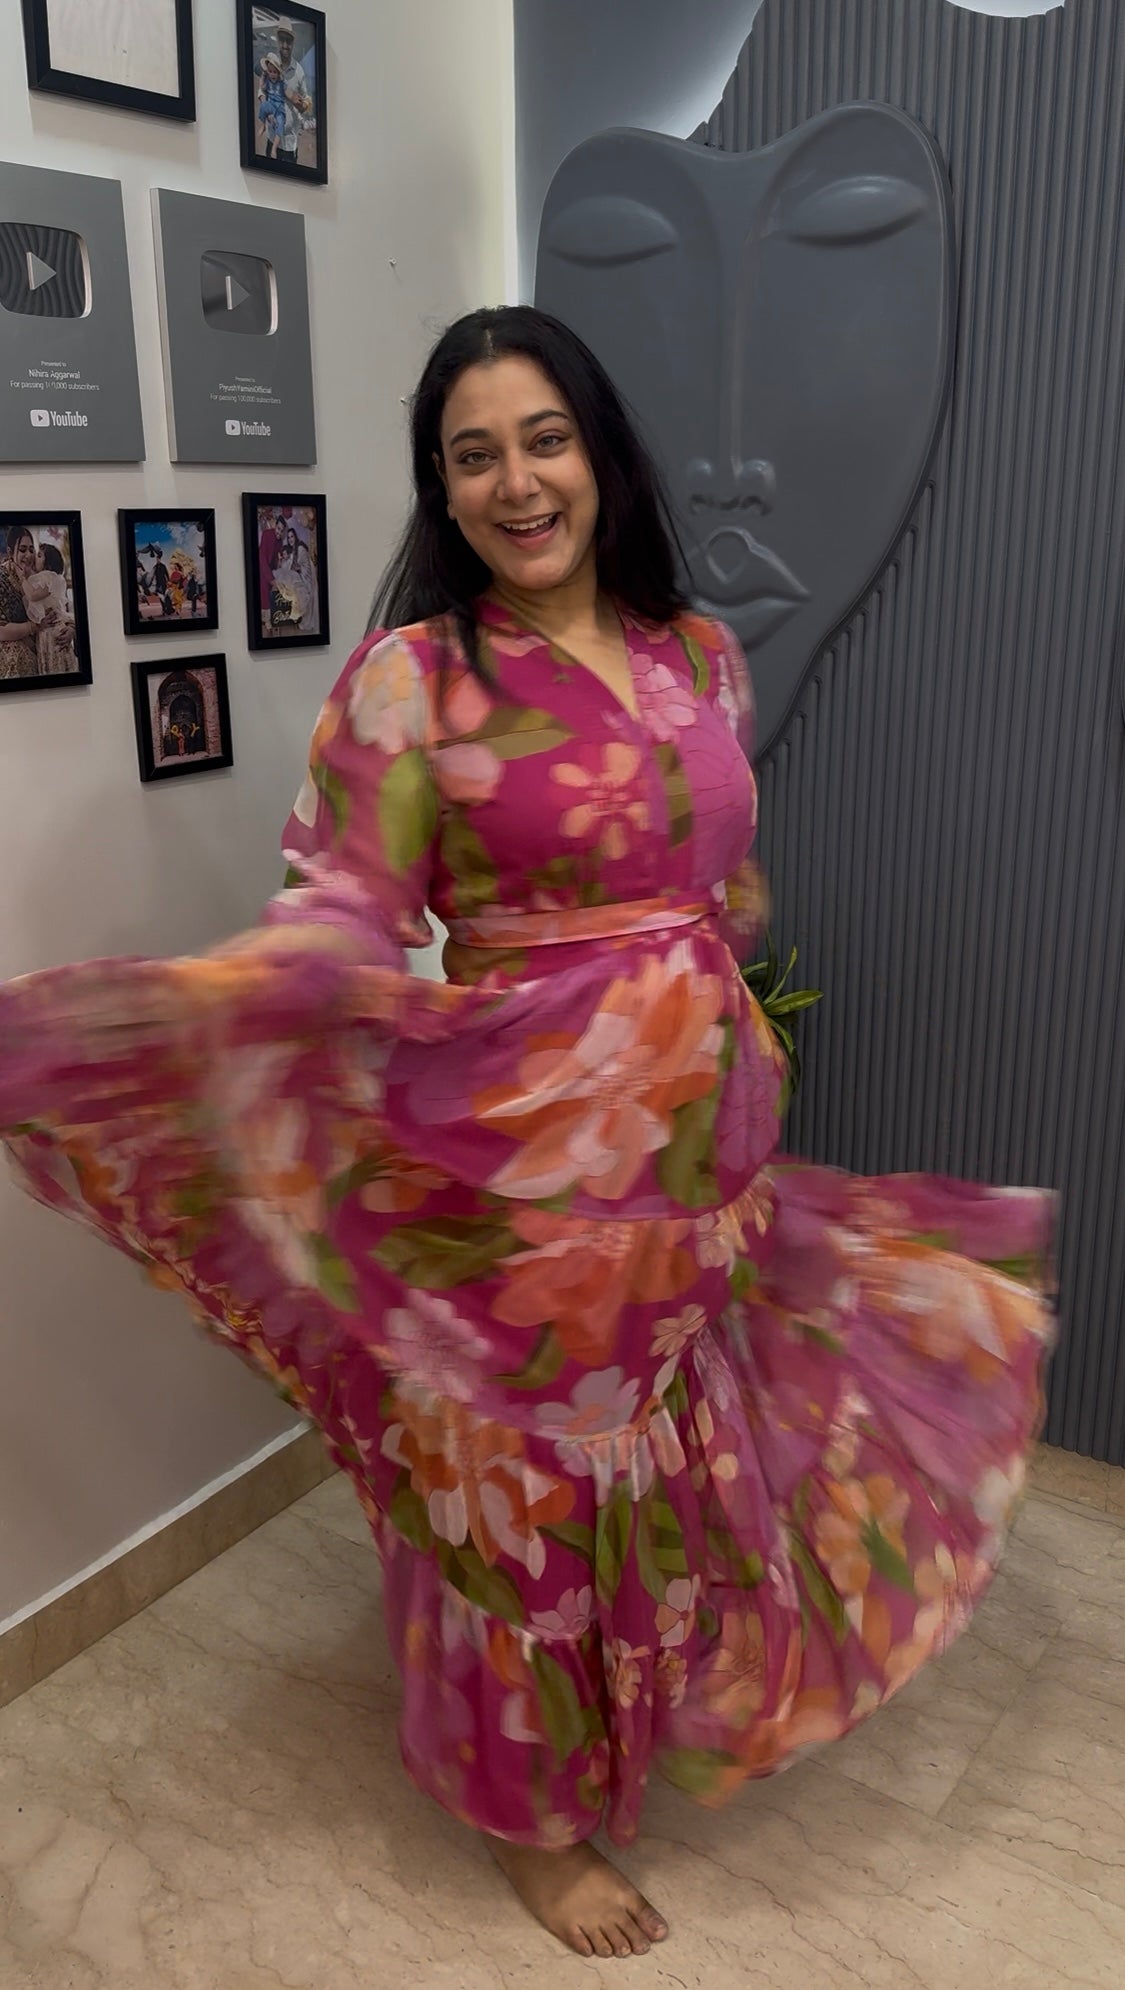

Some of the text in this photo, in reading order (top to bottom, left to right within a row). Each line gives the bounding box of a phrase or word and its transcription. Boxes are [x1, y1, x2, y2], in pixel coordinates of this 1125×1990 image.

[28, 369, 81, 381] Nihira Aggarwal
[10, 380, 20, 388] For
[21, 381, 44, 390] passing
[68, 382, 100, 391] subscribers
[50, 410, 88, 427] YouTube
[241, 421, 271, 436] YouTube
